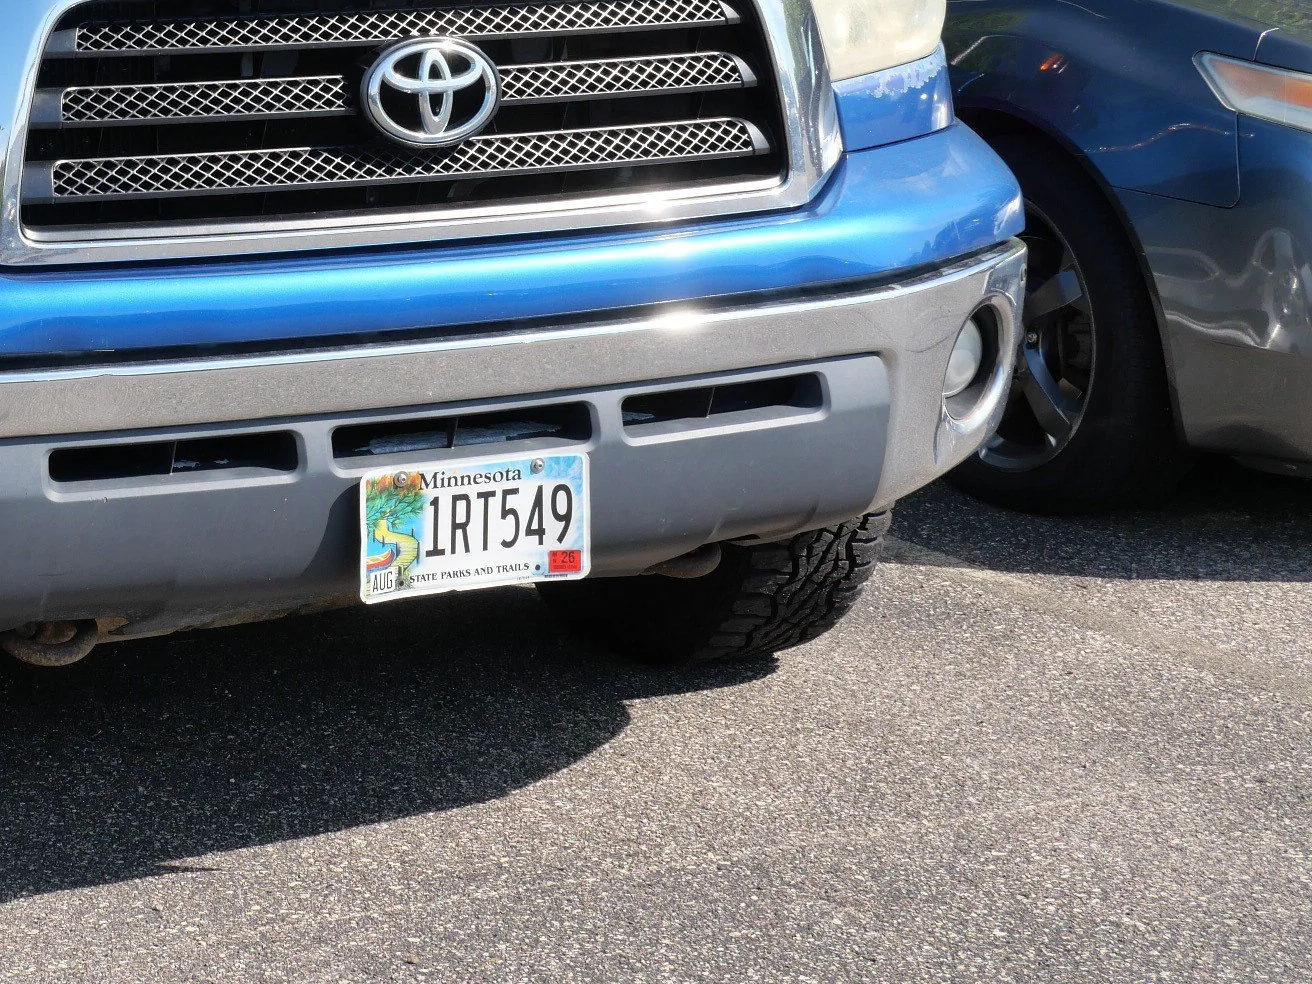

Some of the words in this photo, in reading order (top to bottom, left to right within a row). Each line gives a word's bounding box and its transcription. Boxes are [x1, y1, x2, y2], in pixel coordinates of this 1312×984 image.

[418, 467, 522, 491] Minnesota
[425, 483, 573, 558] 1RT549
[561, 551, 575, 564] 26
[372, 571, 393, 593] AUG
[409, 572, 438, 583] STATE
[440, 568, 471, 580] PARKS
[473, 566, 494, 576] AND
[496, 562, 530, 574] TRAILS
